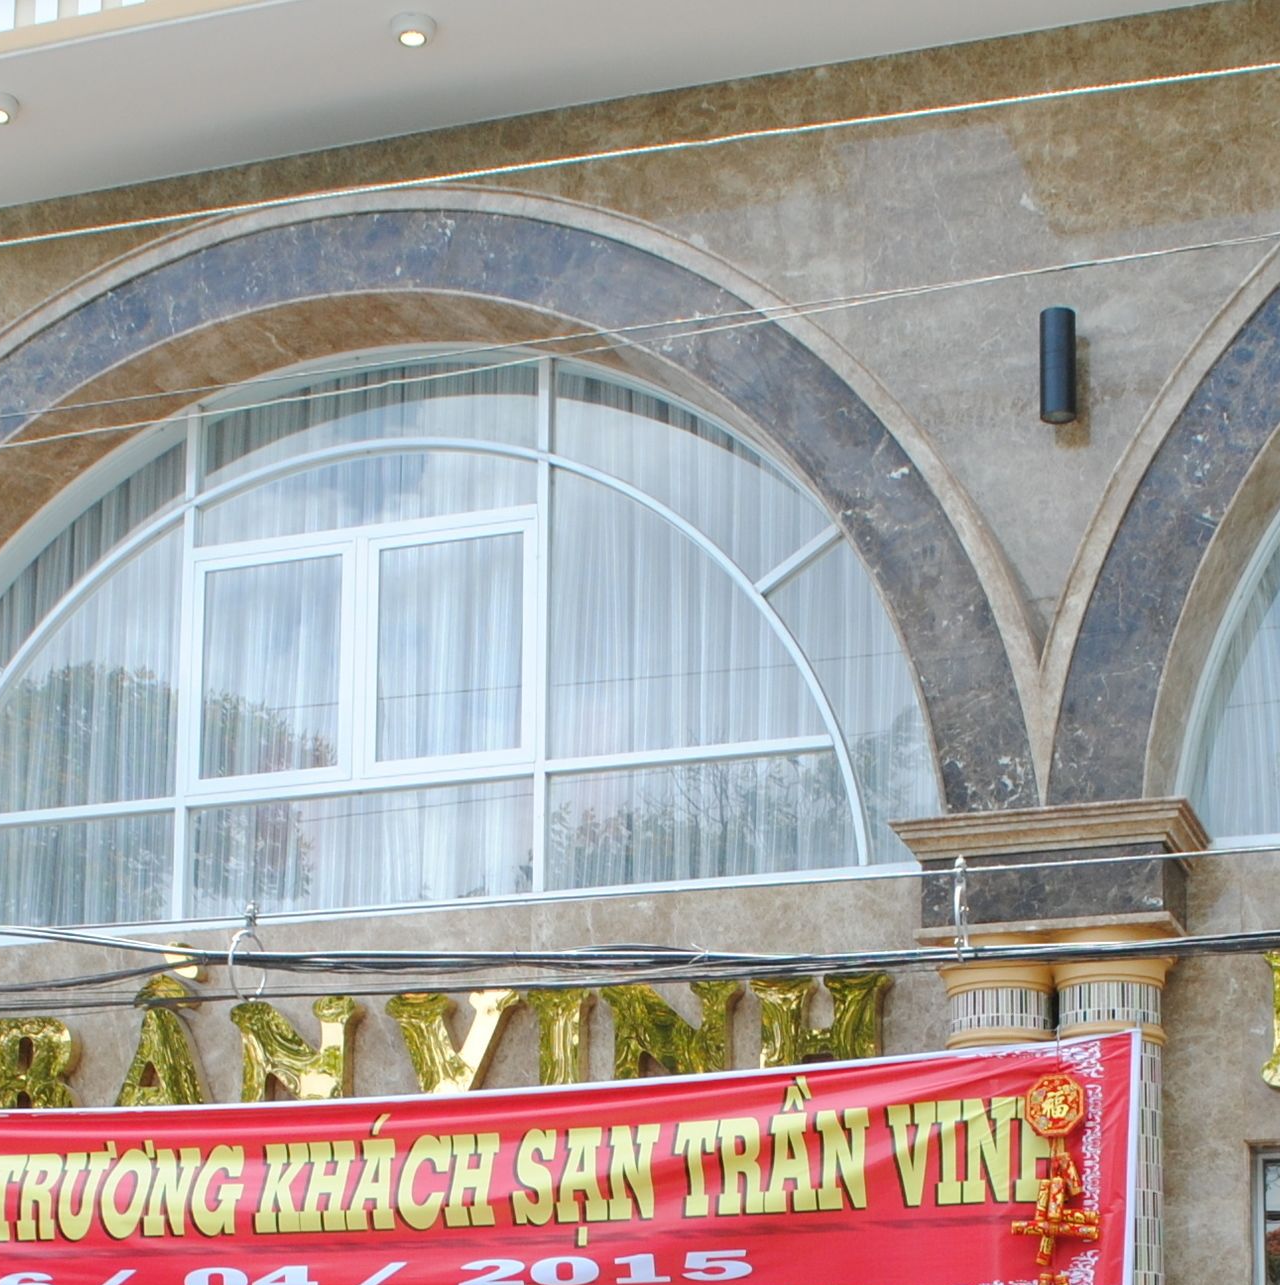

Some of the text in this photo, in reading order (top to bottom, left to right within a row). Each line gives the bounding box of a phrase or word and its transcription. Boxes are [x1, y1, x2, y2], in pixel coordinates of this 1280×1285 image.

[384, 973, 891, 1100] VINH
[253, 1112, 500, 1237] KHÁCH
[513, 1123, 659, 1247] SẠN
[673, 1075, 870, 1216] TRẦN
